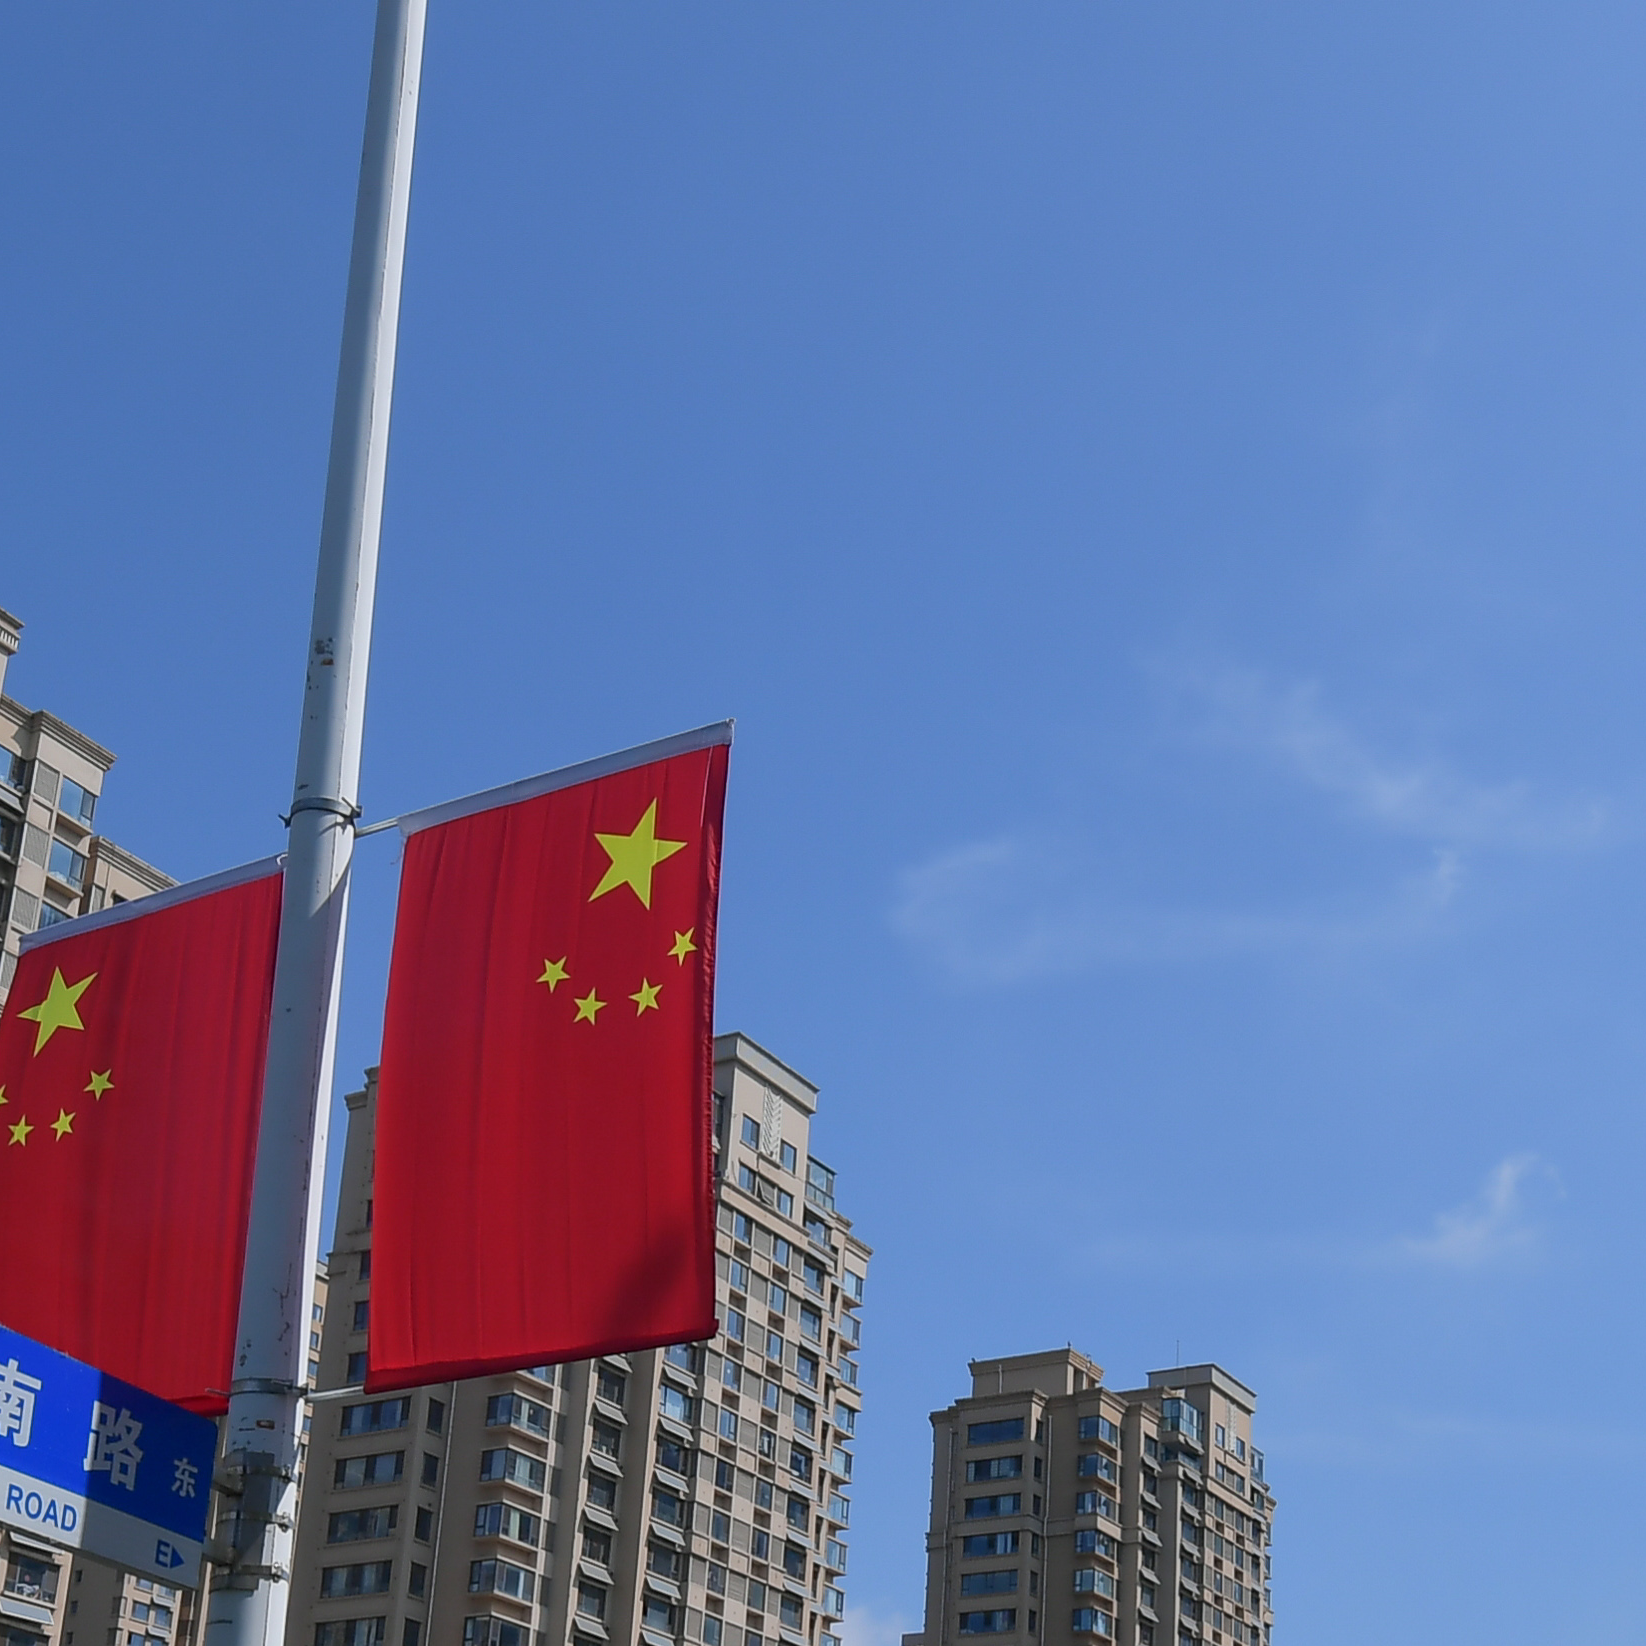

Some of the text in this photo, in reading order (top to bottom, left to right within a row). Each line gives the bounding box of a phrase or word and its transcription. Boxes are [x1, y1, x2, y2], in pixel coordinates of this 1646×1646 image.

[171, 1456, 199, 1499] 东
[5, 1483, 78, 1533] ROAD
[154, 1539, 173, 1569] E
